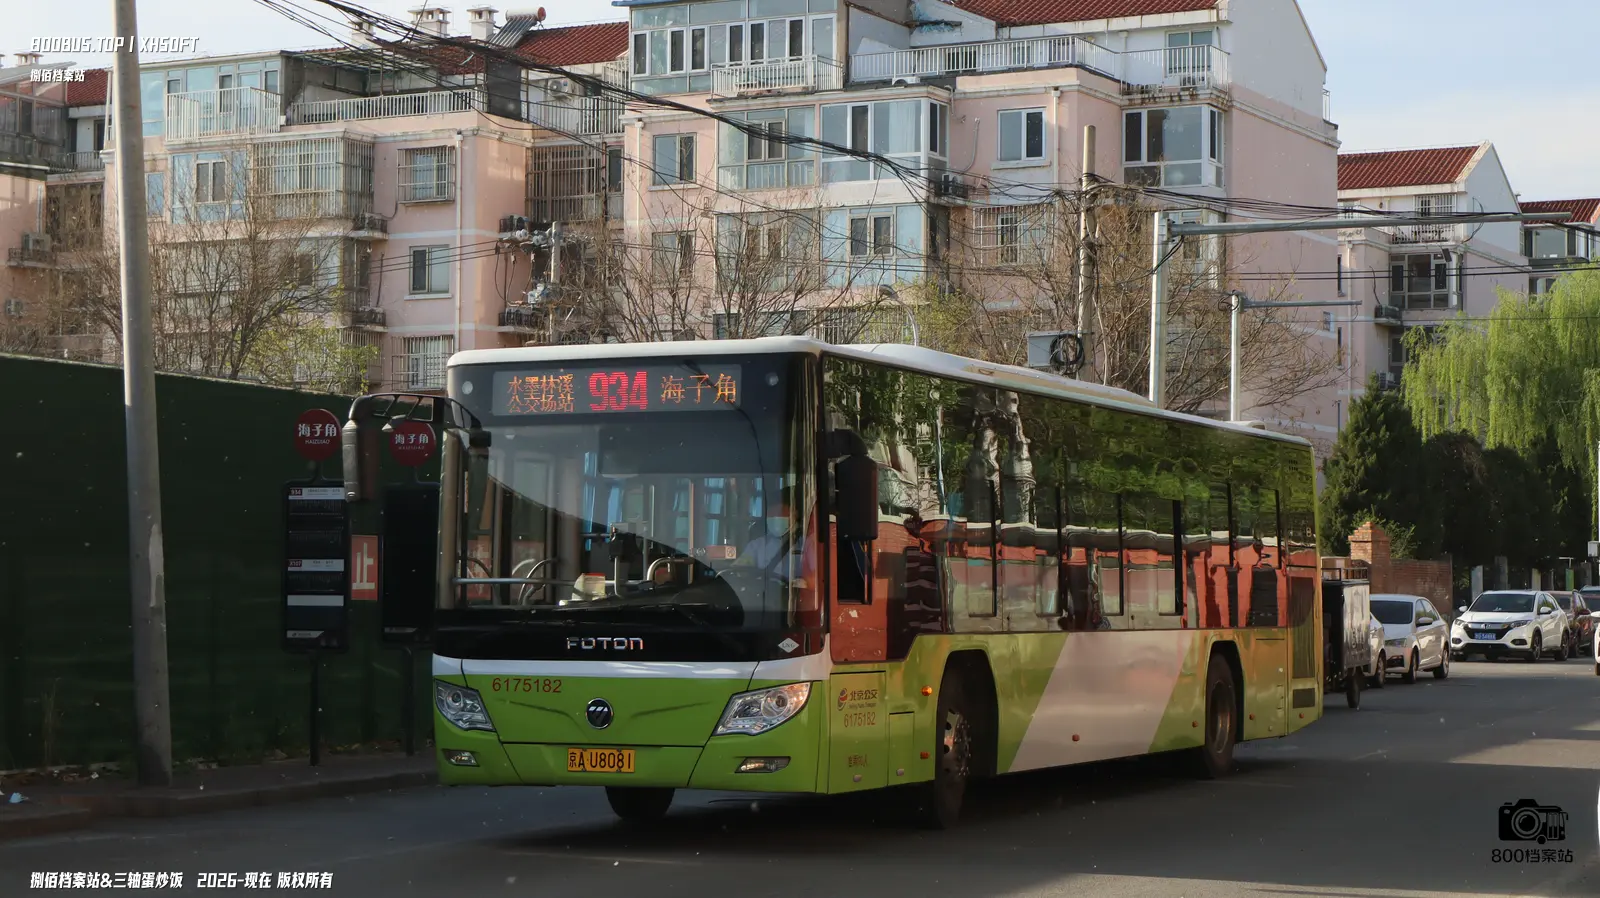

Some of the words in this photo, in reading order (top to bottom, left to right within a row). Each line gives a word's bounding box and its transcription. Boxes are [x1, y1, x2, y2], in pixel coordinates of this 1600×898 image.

[507, 373, 575, 394] 水墨林溪
[588, 371, 649, 411] 934
[660, 373, 737, 404] 海子角
[507, 393, 575, 414] 公交场站
[298, 423, 337, 437] 海子角
[395, 433, 429, 445] 海子角
[351, 542, 376, 590] 止
[566, 637, 643, 650] FOTON
[492, 677, 562, 694] 6175182
[849, 689, 878, 701] 北京公交
[844, 711, 876, 728] 6175182
